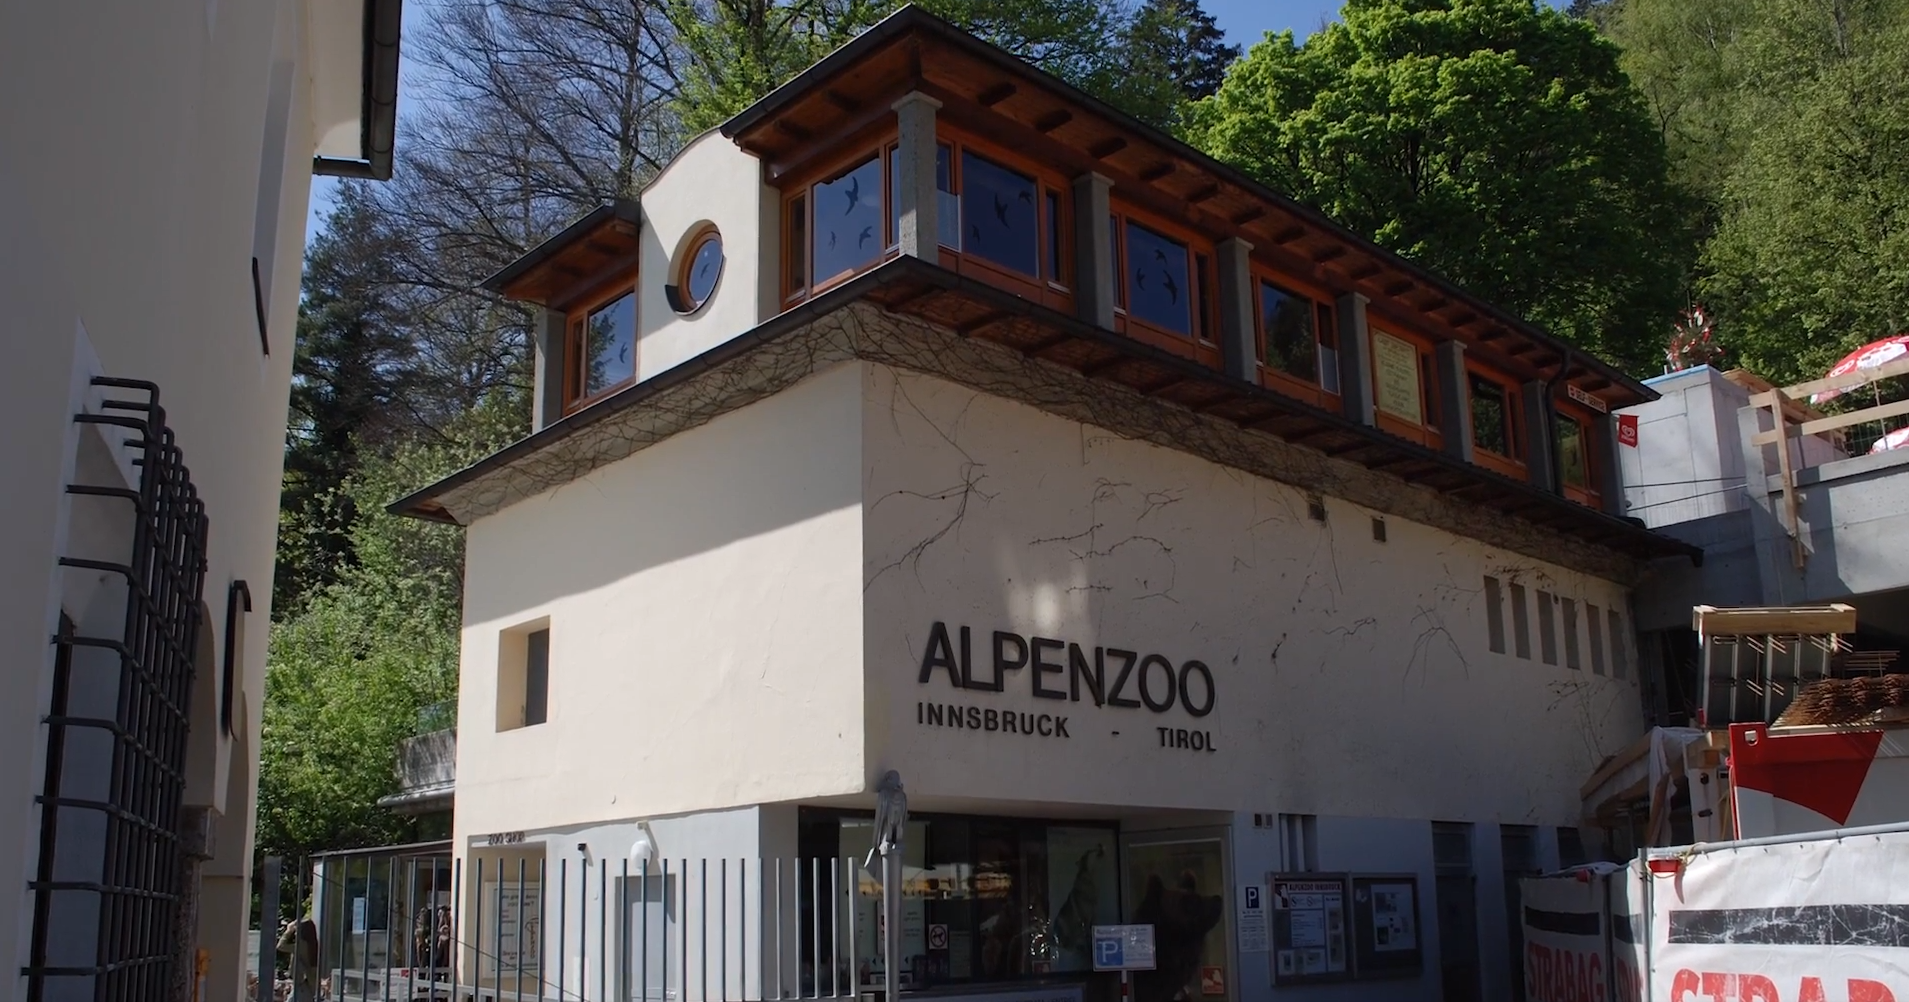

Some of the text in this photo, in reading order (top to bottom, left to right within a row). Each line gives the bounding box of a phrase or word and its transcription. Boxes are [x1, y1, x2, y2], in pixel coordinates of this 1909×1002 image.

[918, 621, 1216, 718] ALPENZOO
[916, 702, 1070, 739] INNSBRUCK
[1156, 726, 1217, 753] TIROL
[1528, 940, 1605, 1002] STRABAG
